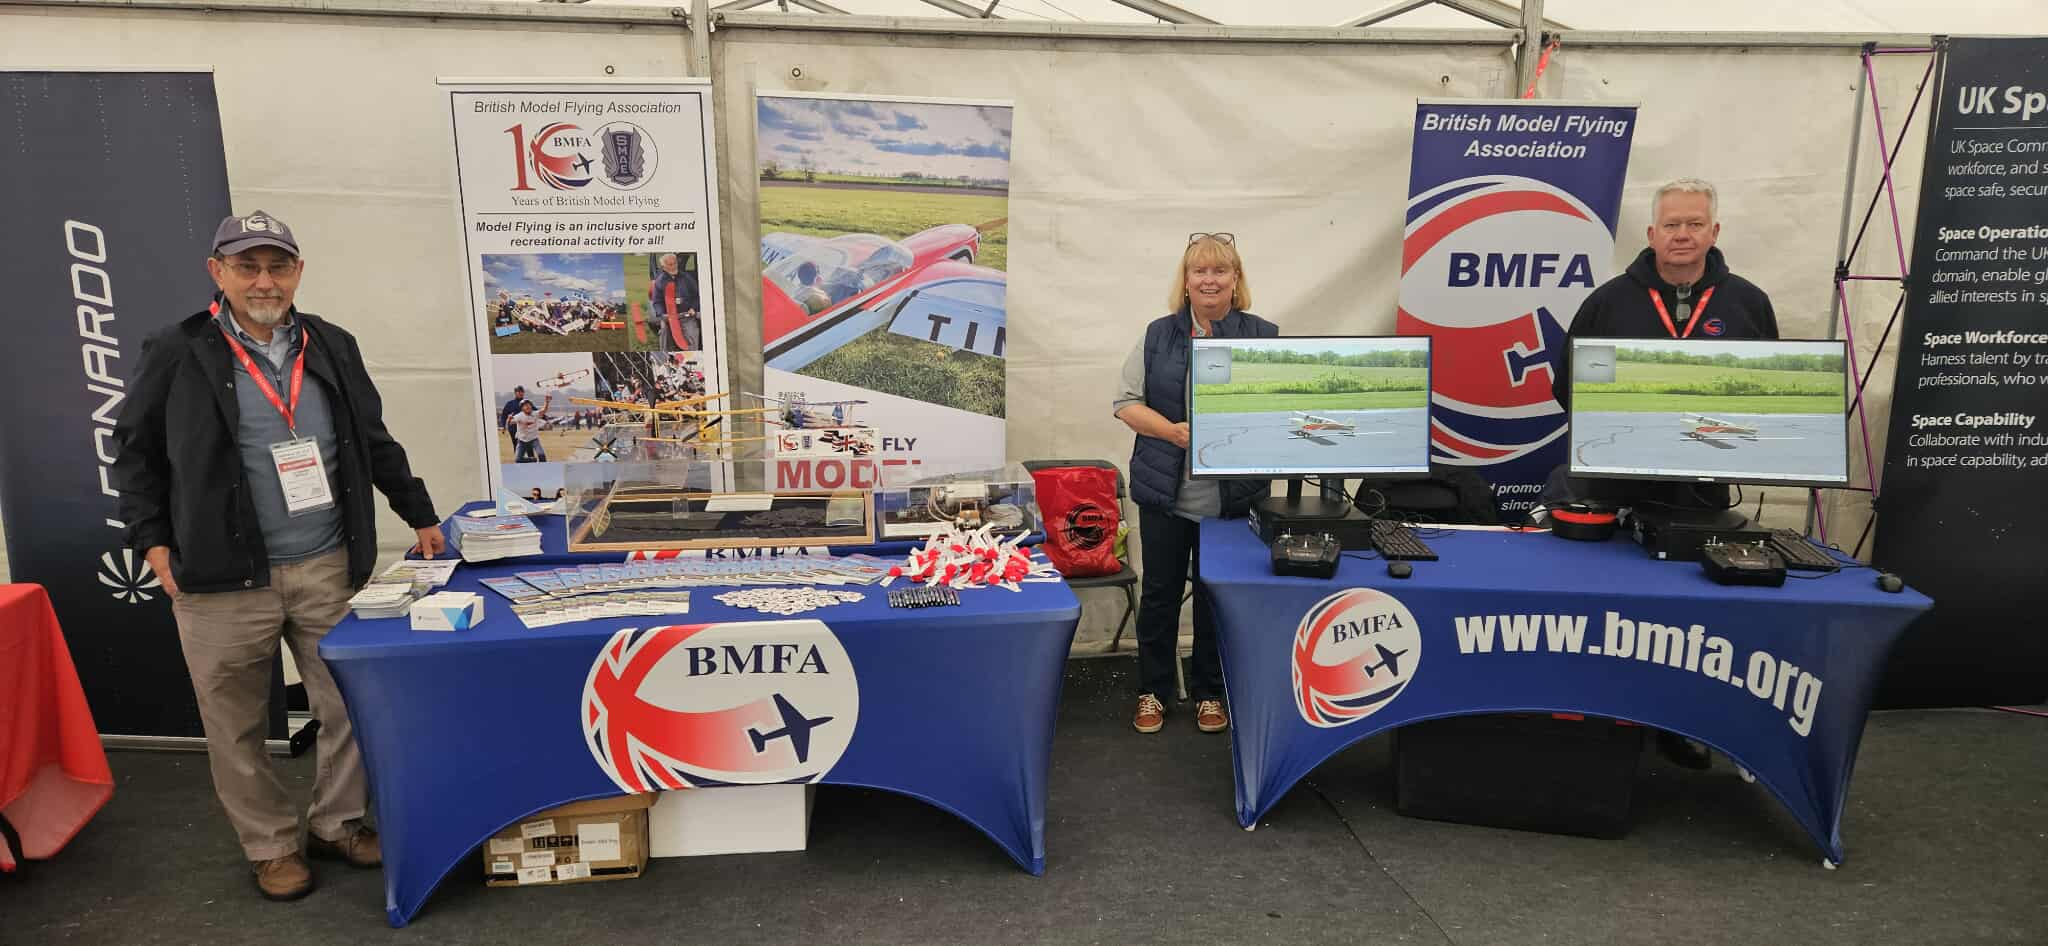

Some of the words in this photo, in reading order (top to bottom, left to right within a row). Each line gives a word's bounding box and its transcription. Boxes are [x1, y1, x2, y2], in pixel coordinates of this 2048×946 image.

[474, 101, 516, 113] British
[520, 101, 561, 113] Model
[564, 101, 604, 116] Flying
[607, 101, 682, 113] Association
[1958, 86, 1998, 114] UK
[2002, 85, 2048, 120] Sp
[1422, 113, 1492, 132] British
[1496, 114, 1561, 133] Model
[1564, 116, 1628, 137] Flying
[553, 136, 592, 148] BMFA
[1463, 140, 1587, 159] Association
[1951, 140, 1967, 154] UK
[1967, 139, 2004, 157] Space
[616, 135, 629, 174] SMAE
[1947, 160, 2007, 177] workforce,
[2010, 159, 2039, 175] and
[1944, 185, 1976, 200] space
[1978, 182, 2007, 198] safe,
[511, 196, 539, 206] Years
[542, 196, 555, 206] of
[556, 196, 590, 206] British
[593, 196, 625, 206] Model
[628, 196, 660, 208] Flying
[475, 222, 512, 232] Model
[515, 222, 552, 234] Flying
[555, 222, 567, 231] is
[569, 223, 584, 231] an
[586, 222, 639, 231] inclusive
[641, 222, 671, 234] sport
[674, 220, 696, 231] and
[1937, 226, 1976, 244] Space
[510, 236, 581, 247] recreational
[583, 235, 625, 248] activity
[628, 235, 644, 246] for
[647, 235, 665, 246] all!
[1935, 246, 1999, 262] Command
[2003, 246, 2028, 260] the
[1447, 252, 1596, 289] BMFA
[1932, 268, 1979, 284] domain,
[1981, 267, 2032, 281] enable
[1929, 289, 1960, 304] allied
[1960, 289, 2018, 303] interests
[2021, 289, 2036, 302] in
[1923, 332, 1962, 349] Space
[1964, 330, 2048, 345] Workforce
[1920, 353, 1967, 366] Harness
[1969, 351, 2010, 365] talent
[2012, 351, 2032, 368] by
[1918, 372, 2000, 390] professionals,
[2003, 371, 2036, 385] who
[1911, 414, 1953, 430] Space
[1954, 412, 2036, 429] Capability
[882, 437, 917, 451] FLY
[1908, 432, 1980, 448] Collaborate
[1983, 432, 2015, 446] with
[1906, 455, 1918, 467] in
[1921, 456, 1957, 470] space
[1959, 452, 2027, 470] capability,
[1330, 611, 1405, 646] BMFA
[686, 643, 831, 678] BMFA
[1454, 611, 1823, 737] www.bmfa.org
